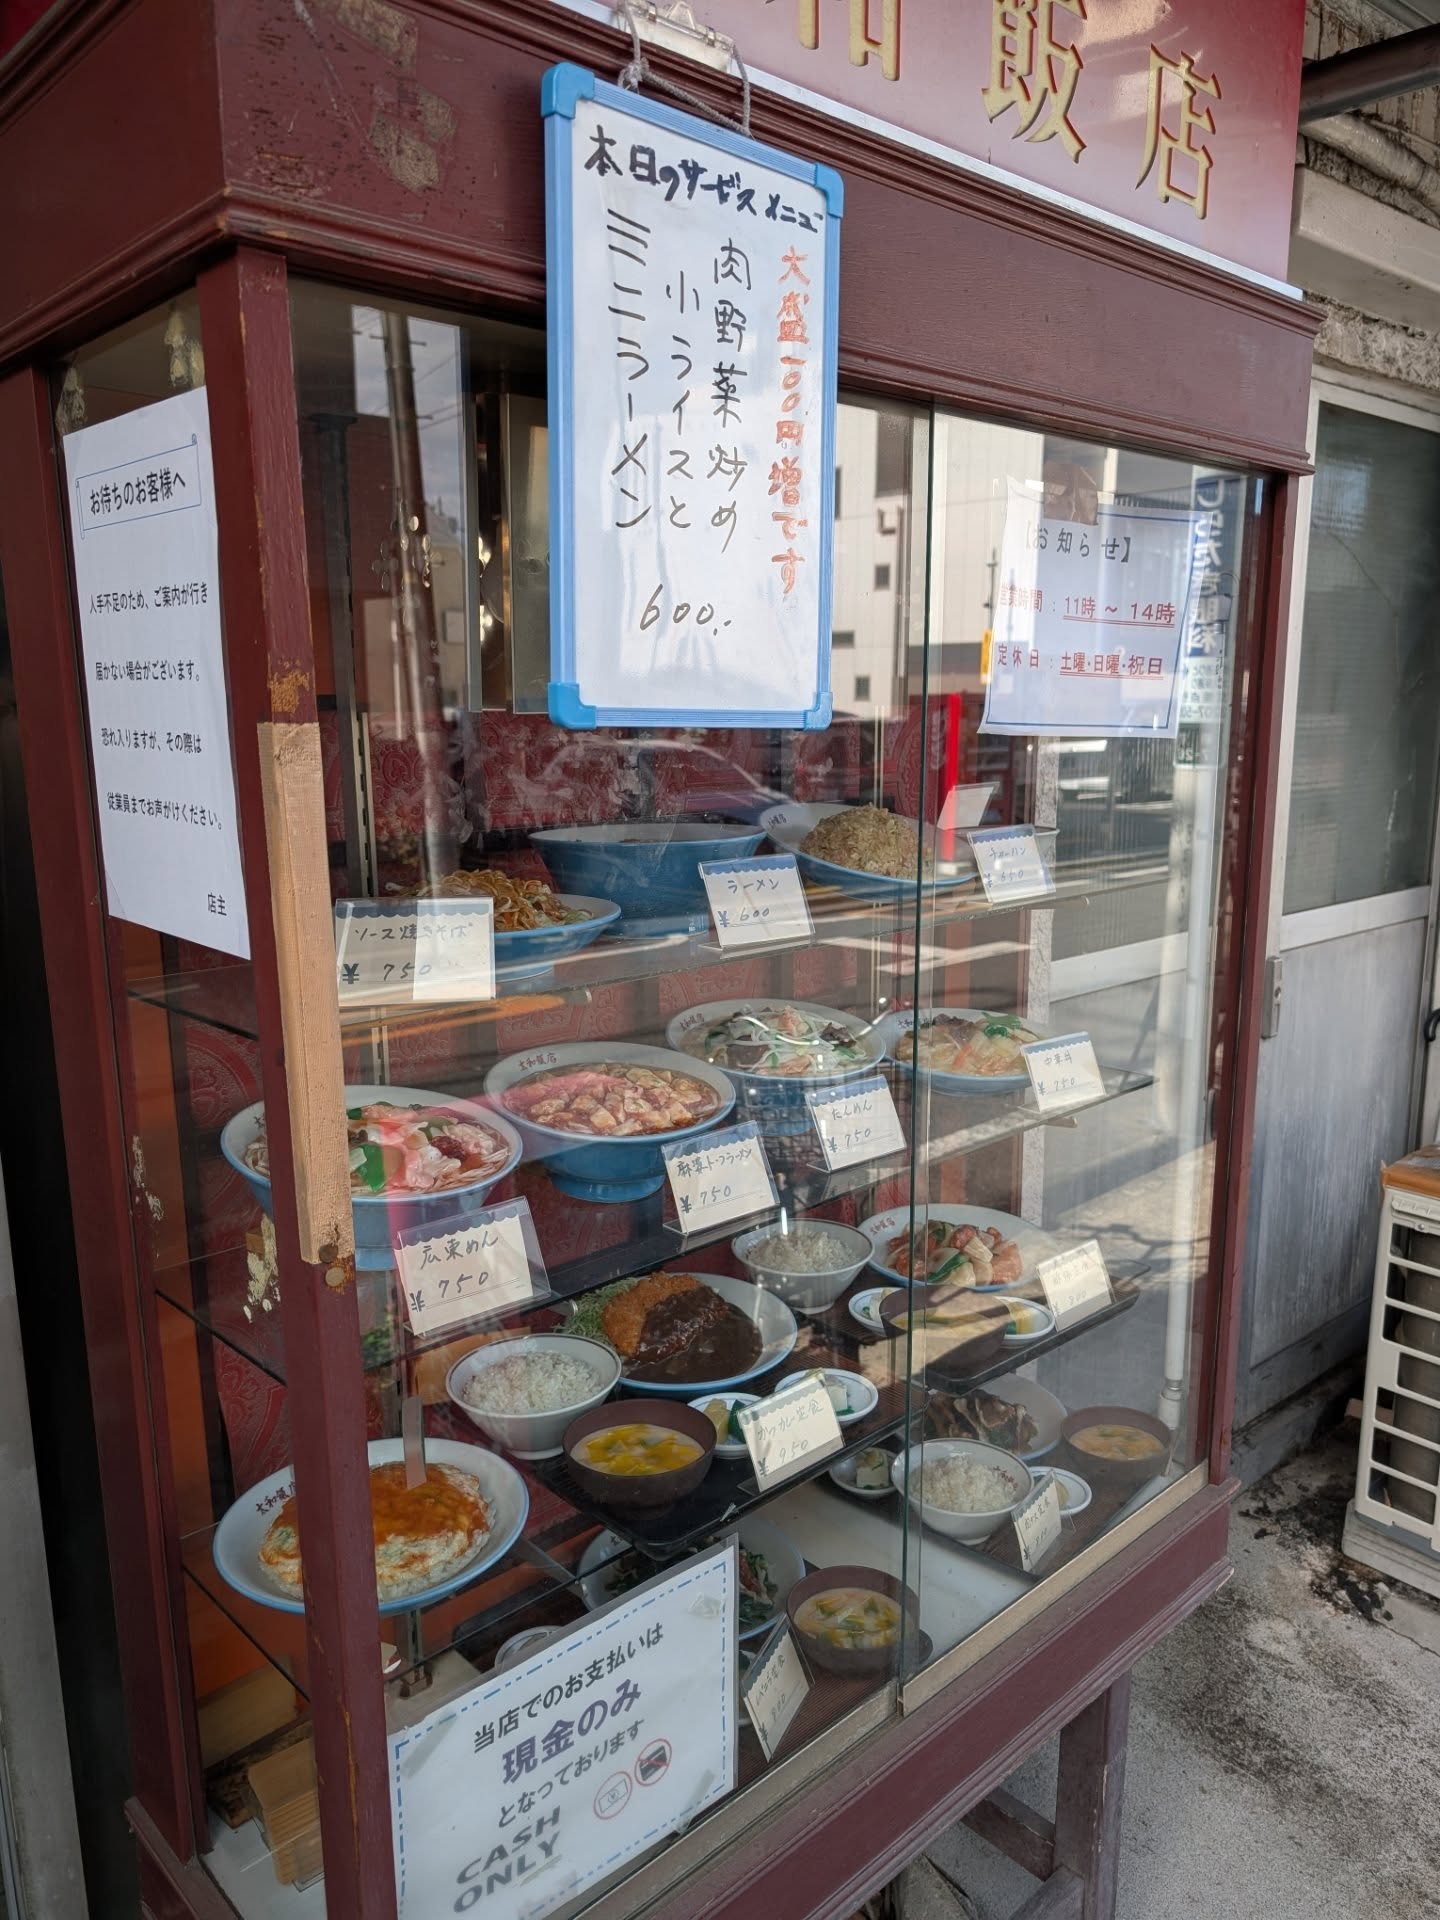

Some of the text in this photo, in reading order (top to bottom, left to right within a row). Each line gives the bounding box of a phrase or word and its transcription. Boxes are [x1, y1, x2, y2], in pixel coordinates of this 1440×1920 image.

[606, 209, 652, 529] ミニラーメン
[665, 270, 700, 530] 小ライスと
[707, 238, 753, 553] 肉野菜炒め
[90, 468, 187, 515] お待ちのお客様へ
[89, 582, 208, 615] 人手不足のため、ご案内が行き
[95, 659, 200, 682] 届かない場合がございます。
[101, 727, 202, 754] 恐れ入りますが、その際は
[107, 791, 222, 830] 従業員までお声がけください。
[207, 892, 228, 916] 店主
[727, 878, 780, 895] ラーメン
[355, 921, 474, 942] ソース焼きそば
[831, 1099, 873, 1121] たんめん
[420, 1230, 499, 1270] 広東めん
[474, 1622, 664, 1754] 当店でのお支払いは
[502, 1679, 642, 1785] 現金のみ
[498, 1719, 645, 1829] となっております
[456, 1805, 562, 1884] CASH
[453, 1833, 560, 1914] ONLY
